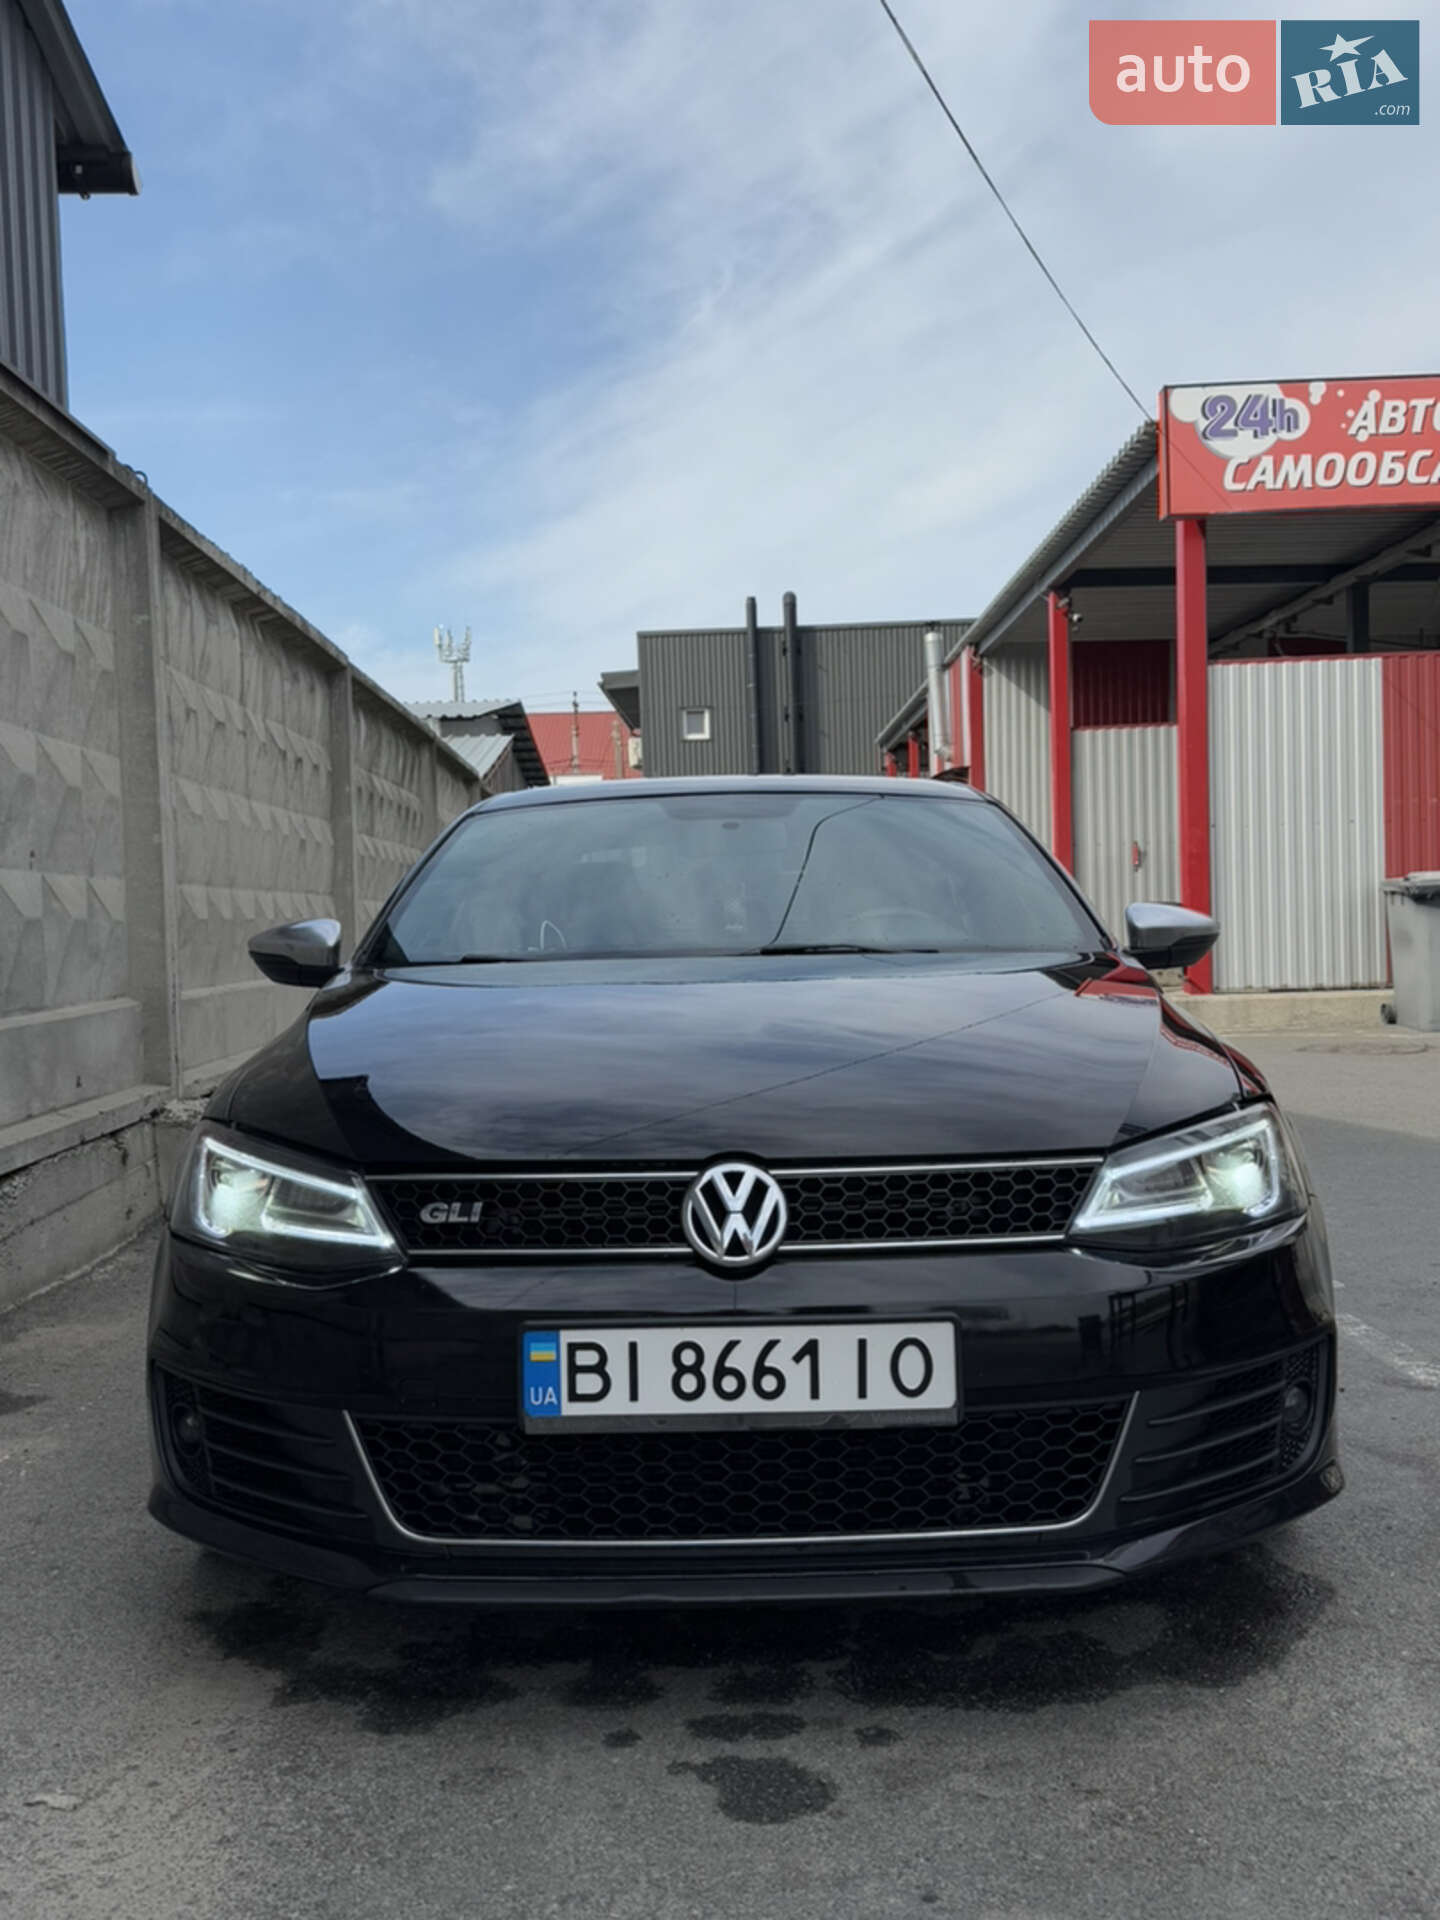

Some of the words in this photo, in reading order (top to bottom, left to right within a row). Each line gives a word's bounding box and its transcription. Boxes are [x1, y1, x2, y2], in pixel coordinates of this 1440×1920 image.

[1201, 394, 1299, 440] 24h
[1348, 397, 1440, 436] АВТ
[419, 1201, 483, 1224] GLI
[567, 1341, 638, 1402] BI
[671, 1339, 820, 1401] 8661
[530, 1386, 558, 1405] UA
